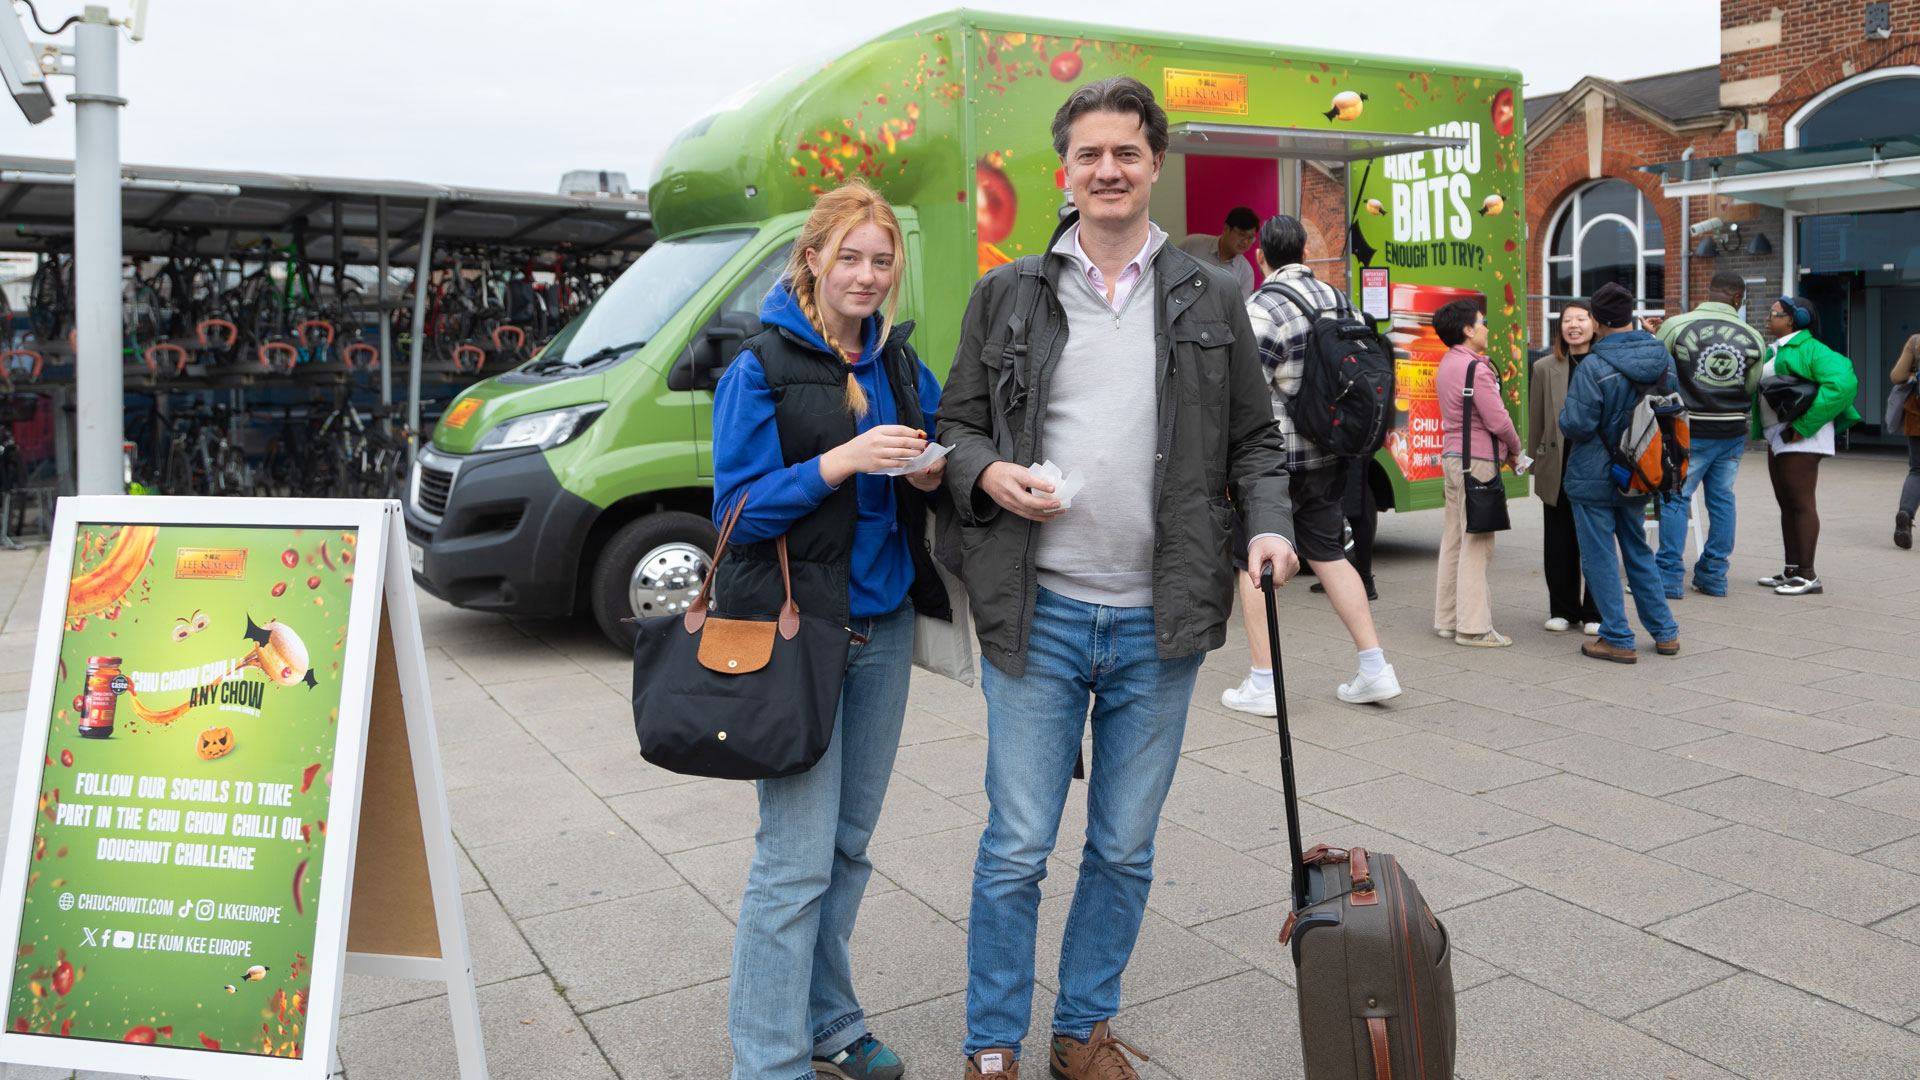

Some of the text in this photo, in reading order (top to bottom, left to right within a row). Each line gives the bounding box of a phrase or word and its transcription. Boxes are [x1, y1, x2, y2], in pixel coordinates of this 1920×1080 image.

[1174, 86, 1240, 101] LEE KUM KEE
[1384, 121, 1480, 180] ARE YOU
[1392, 173, 1472, 242] BATS
[1385, 240, 1484, 271] ENOUGH TO TRY?
[1400, 376, 1436, 388] LEE KUM
[1413, 418, 1438, 432] CHIU
[183, 560, 238, 570] LEE KUM KEE
[131, 670, 160, 692] CHIU
[160, 666, 200, 692] CHOW
[201, 657, 244, 686] CHILLI
[190, 680, 264, 710] ANY CHOW
[75, 772, 293, 807] FOLLOW OUR SOCIALS TO TAKE
[56, 803, 304, 841] PART IN THE CHIU CHOW CHILLI OIL
[96, 838, 256, 870] DOUGHNUT CHALLENGE
[78, 893, 281, 924] CHIUCHOWIT.COM LKKEUROPE
[137, 932, 252, 957] LEE KUM KEE EUROPE
